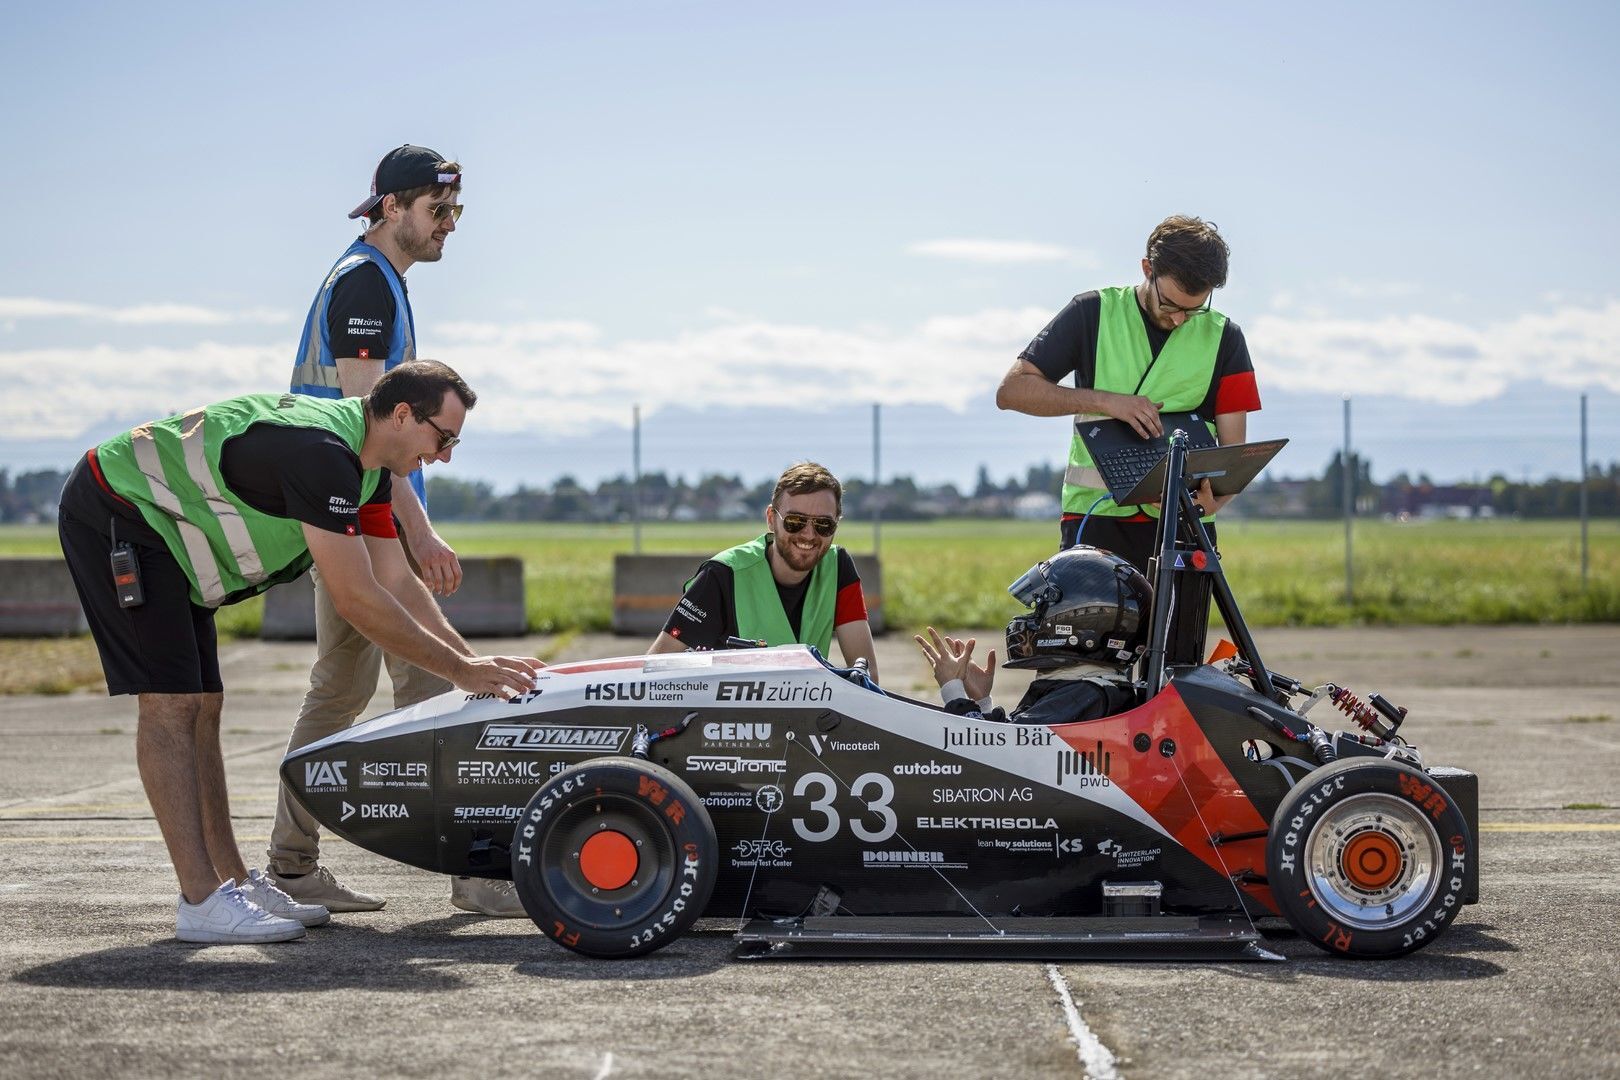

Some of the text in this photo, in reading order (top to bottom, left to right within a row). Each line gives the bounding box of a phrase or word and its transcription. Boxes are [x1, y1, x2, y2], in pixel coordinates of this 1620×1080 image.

[584, 681, 646, 701] HSLU
[649, 680, 709, 691] Hochschule
[464, 692, 500, 702] RUA
[649, 691, 684, 701] Luzern
[484, 728, 624, 747] CNC DYNAMIX
[703, 722, 772, 741] GENU
[942, 726, 1056, 750] Julius Bär
[830, 740, 880, 751] Vincotech
[361, 762, 428, 777] KISTLER
[457, 761, 541, 777] FERAMIC
[685, 755, 787, 774] Swaytronic
[892, 760, 962, 776] autobau
[305, 761, 348, 786] VAC
[1079, 775, 1110, 789] pwb
[699, 797, 753, 808] ecnopinz
[932, 787, 1033, 803] SIBATRON AG
[361, 804, 410, 819] DEKRA
[453, 804, 526, 820] speedgo
[791, 771, 898, 844] 33
[518, 772, 587, 867] Hoosier
[916, 817, 1059, 830] ELEKTRISOLA
[1280, 775, 1345, 876] Hoosier
[977, 838, 1052, 849] lean key solutions
[1117, 847, 1162, 859] SWITZERLAND
[1117, 855, 1155, 864] INNOVATION
[731, 858, 793, 868] Dynamic Test Center
[630, 855, 698, 947] Hoosier
[1402, 847, 1466, 948] Hoosier
